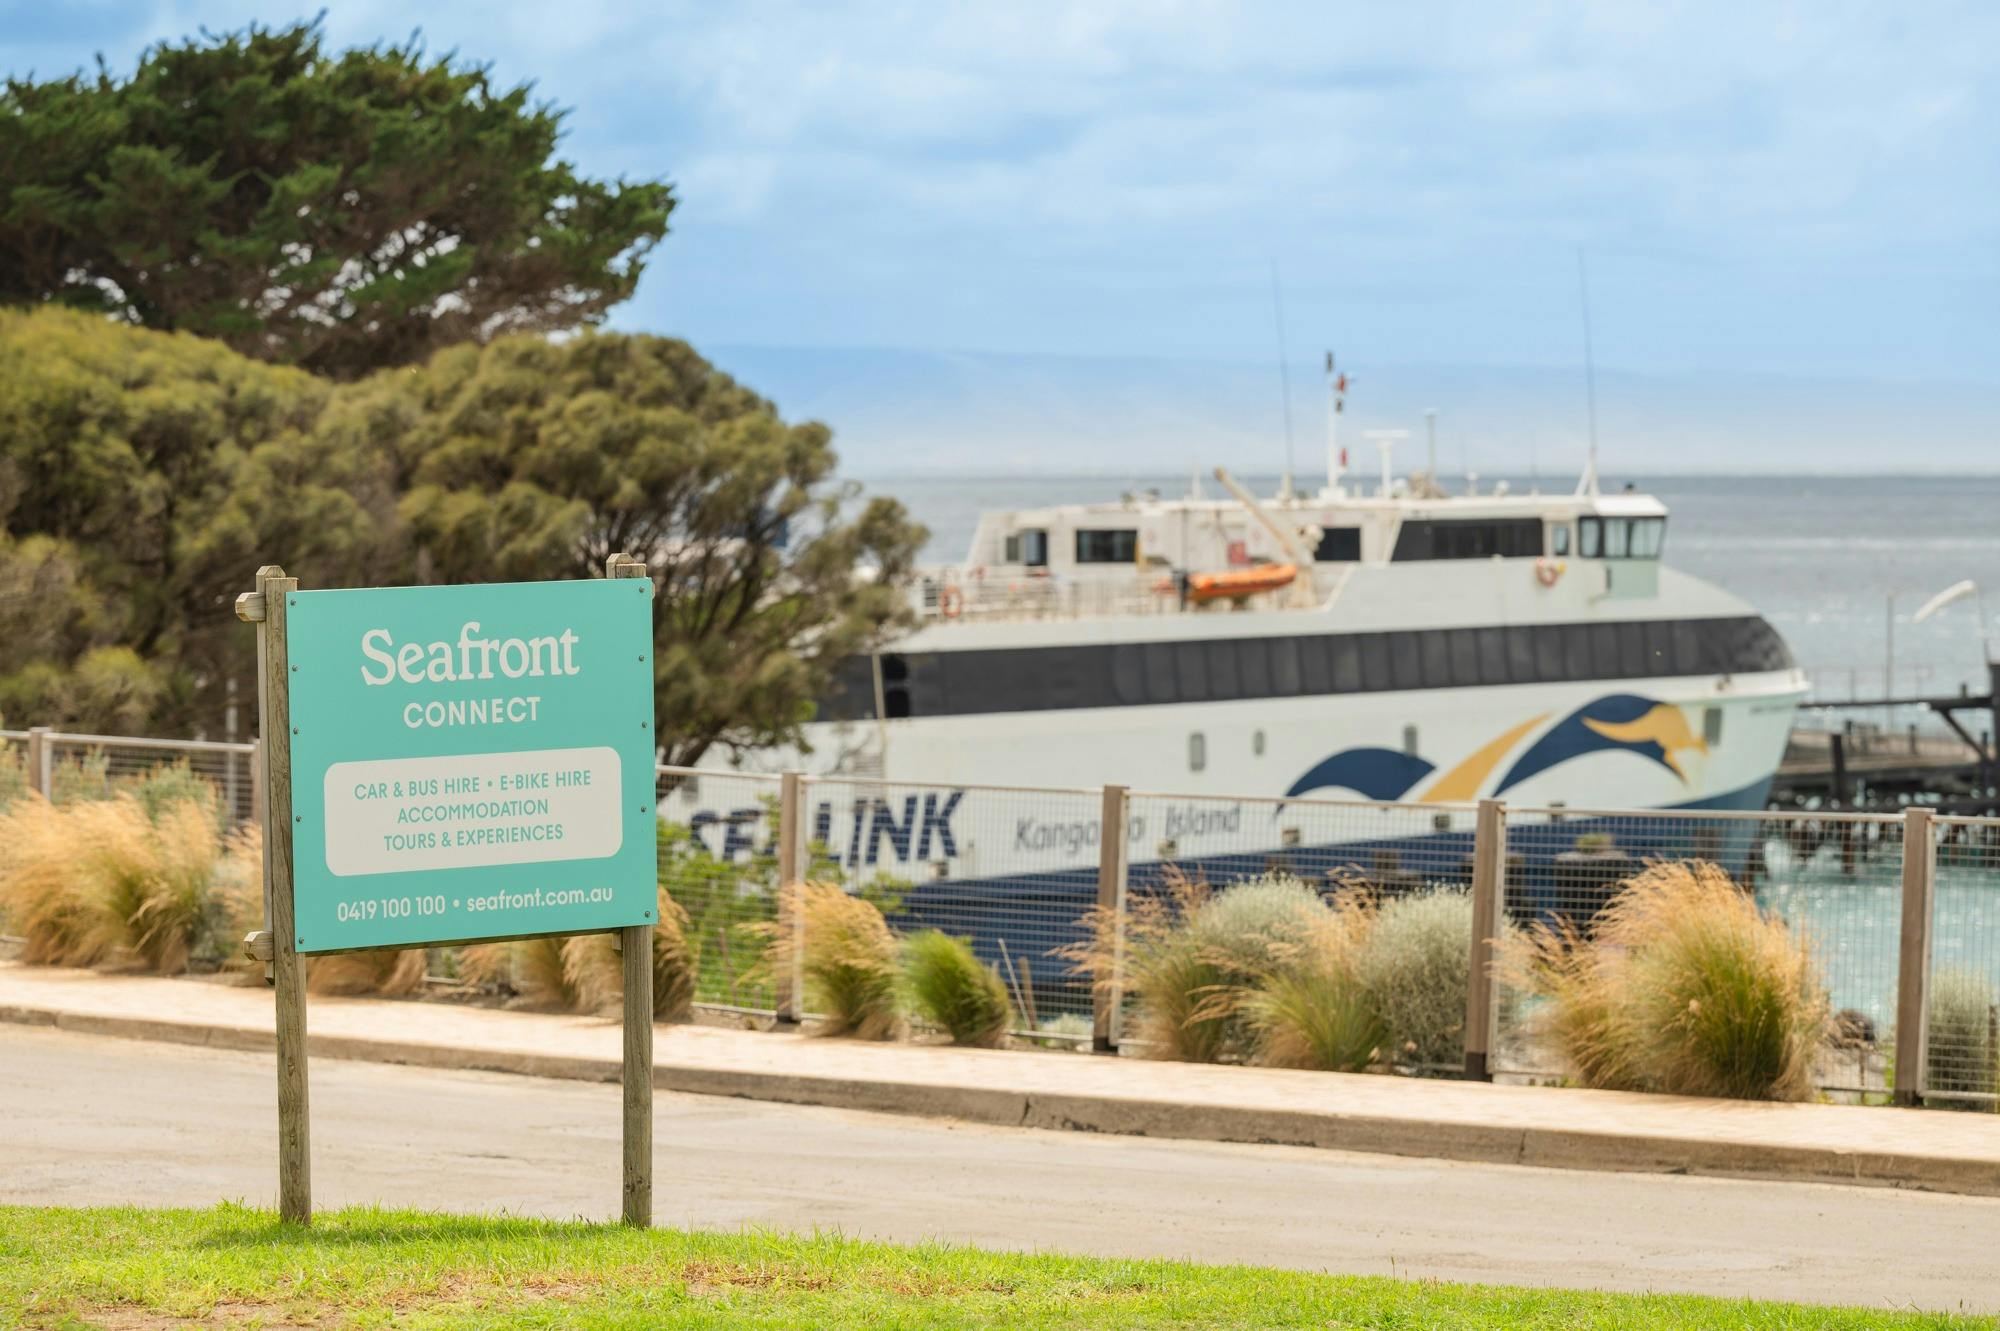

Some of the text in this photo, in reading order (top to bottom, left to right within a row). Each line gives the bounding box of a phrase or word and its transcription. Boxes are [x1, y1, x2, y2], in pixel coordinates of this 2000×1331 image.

[360, 621, 581, 686] Seafront
[403, 696, 541, 729] CONNECT
[354, 769, 592, 801] CAR & BUS HIRE E-BIKE HIRE
[397, 798, 550, 825] ACCOMMODATION
[383, 823, 564, 851] TOURS & EXPERIENCES
[691, 792, 965, 872] SELINK
[1014, 803, 1241, 859] Kangao Island
[337, 886, 614, 923] 0419 100 100 seafront.com.au
